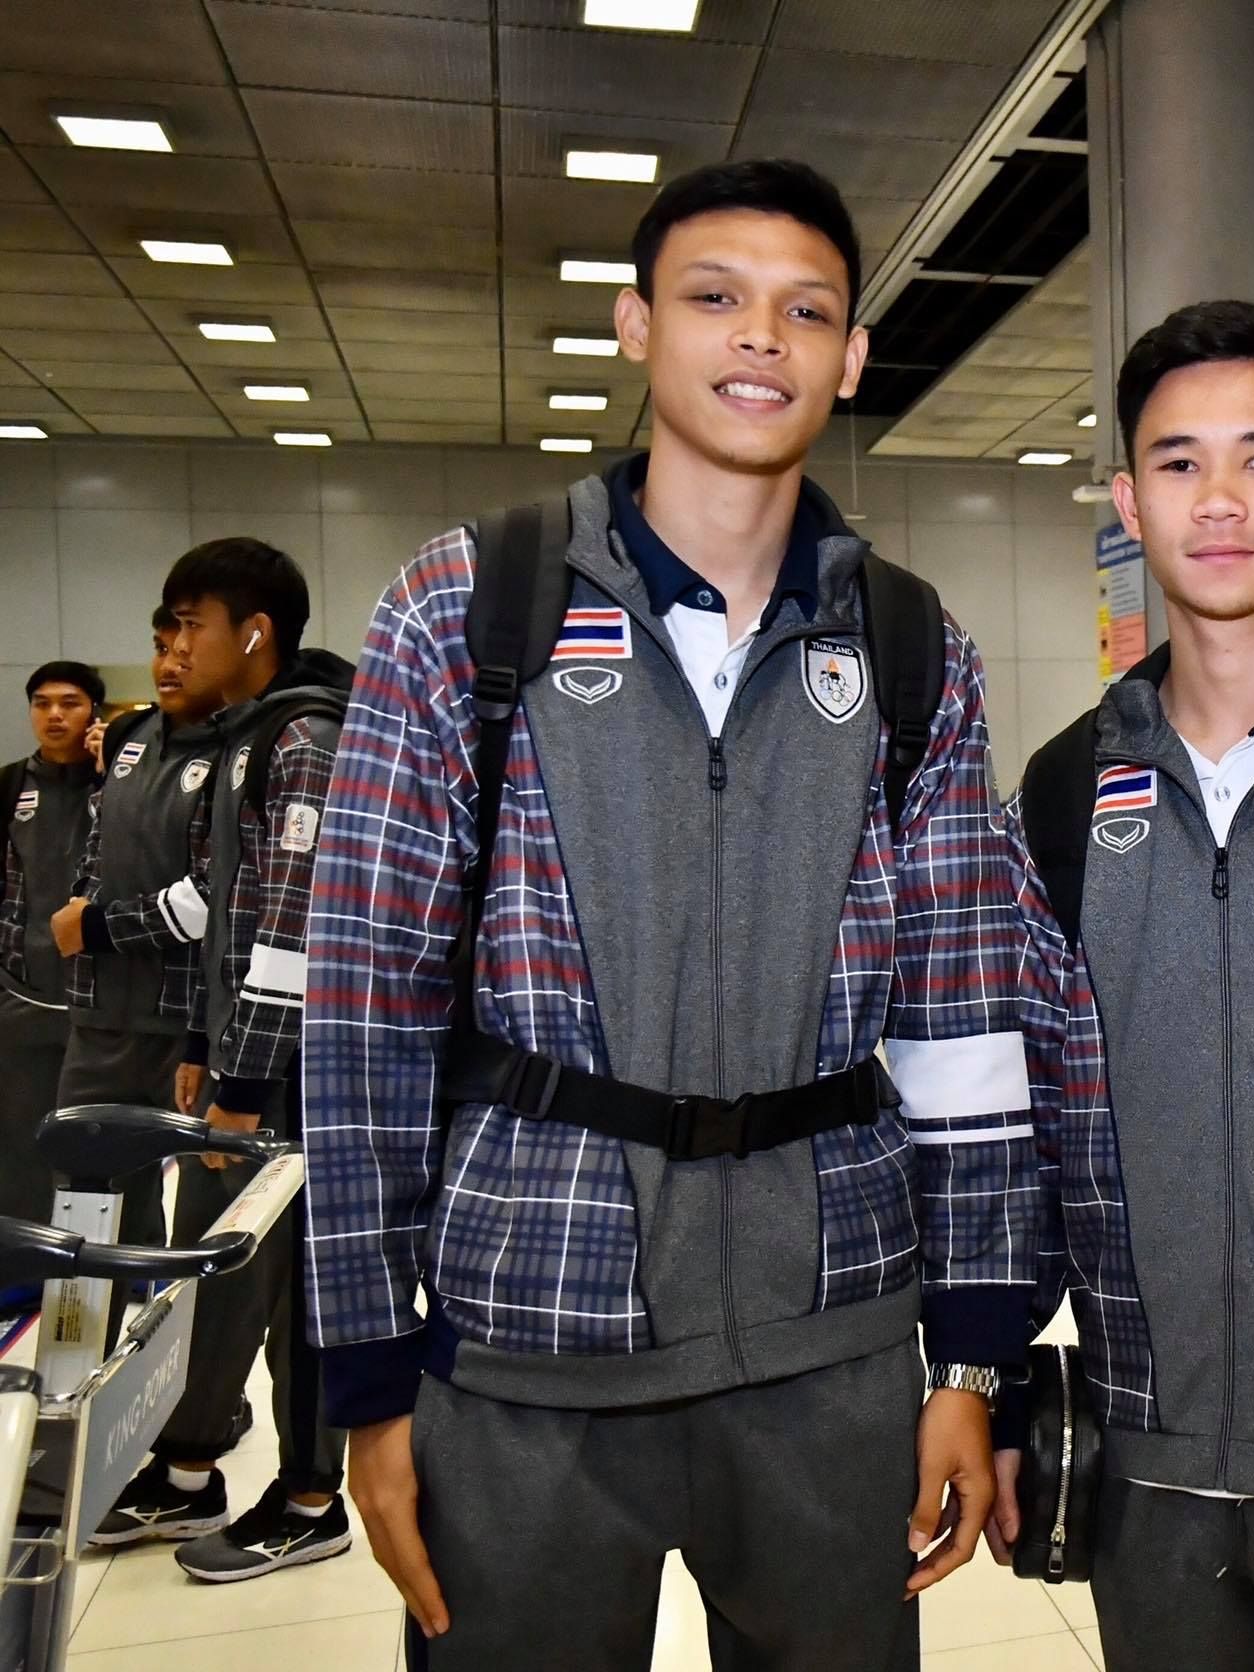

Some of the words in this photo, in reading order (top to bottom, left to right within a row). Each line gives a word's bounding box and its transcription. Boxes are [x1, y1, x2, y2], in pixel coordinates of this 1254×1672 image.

[811, 641, 854, 656] THAILAND
[104, 1393, 142, 1472] KING
[142, 1337, 181, 1419] POWER
